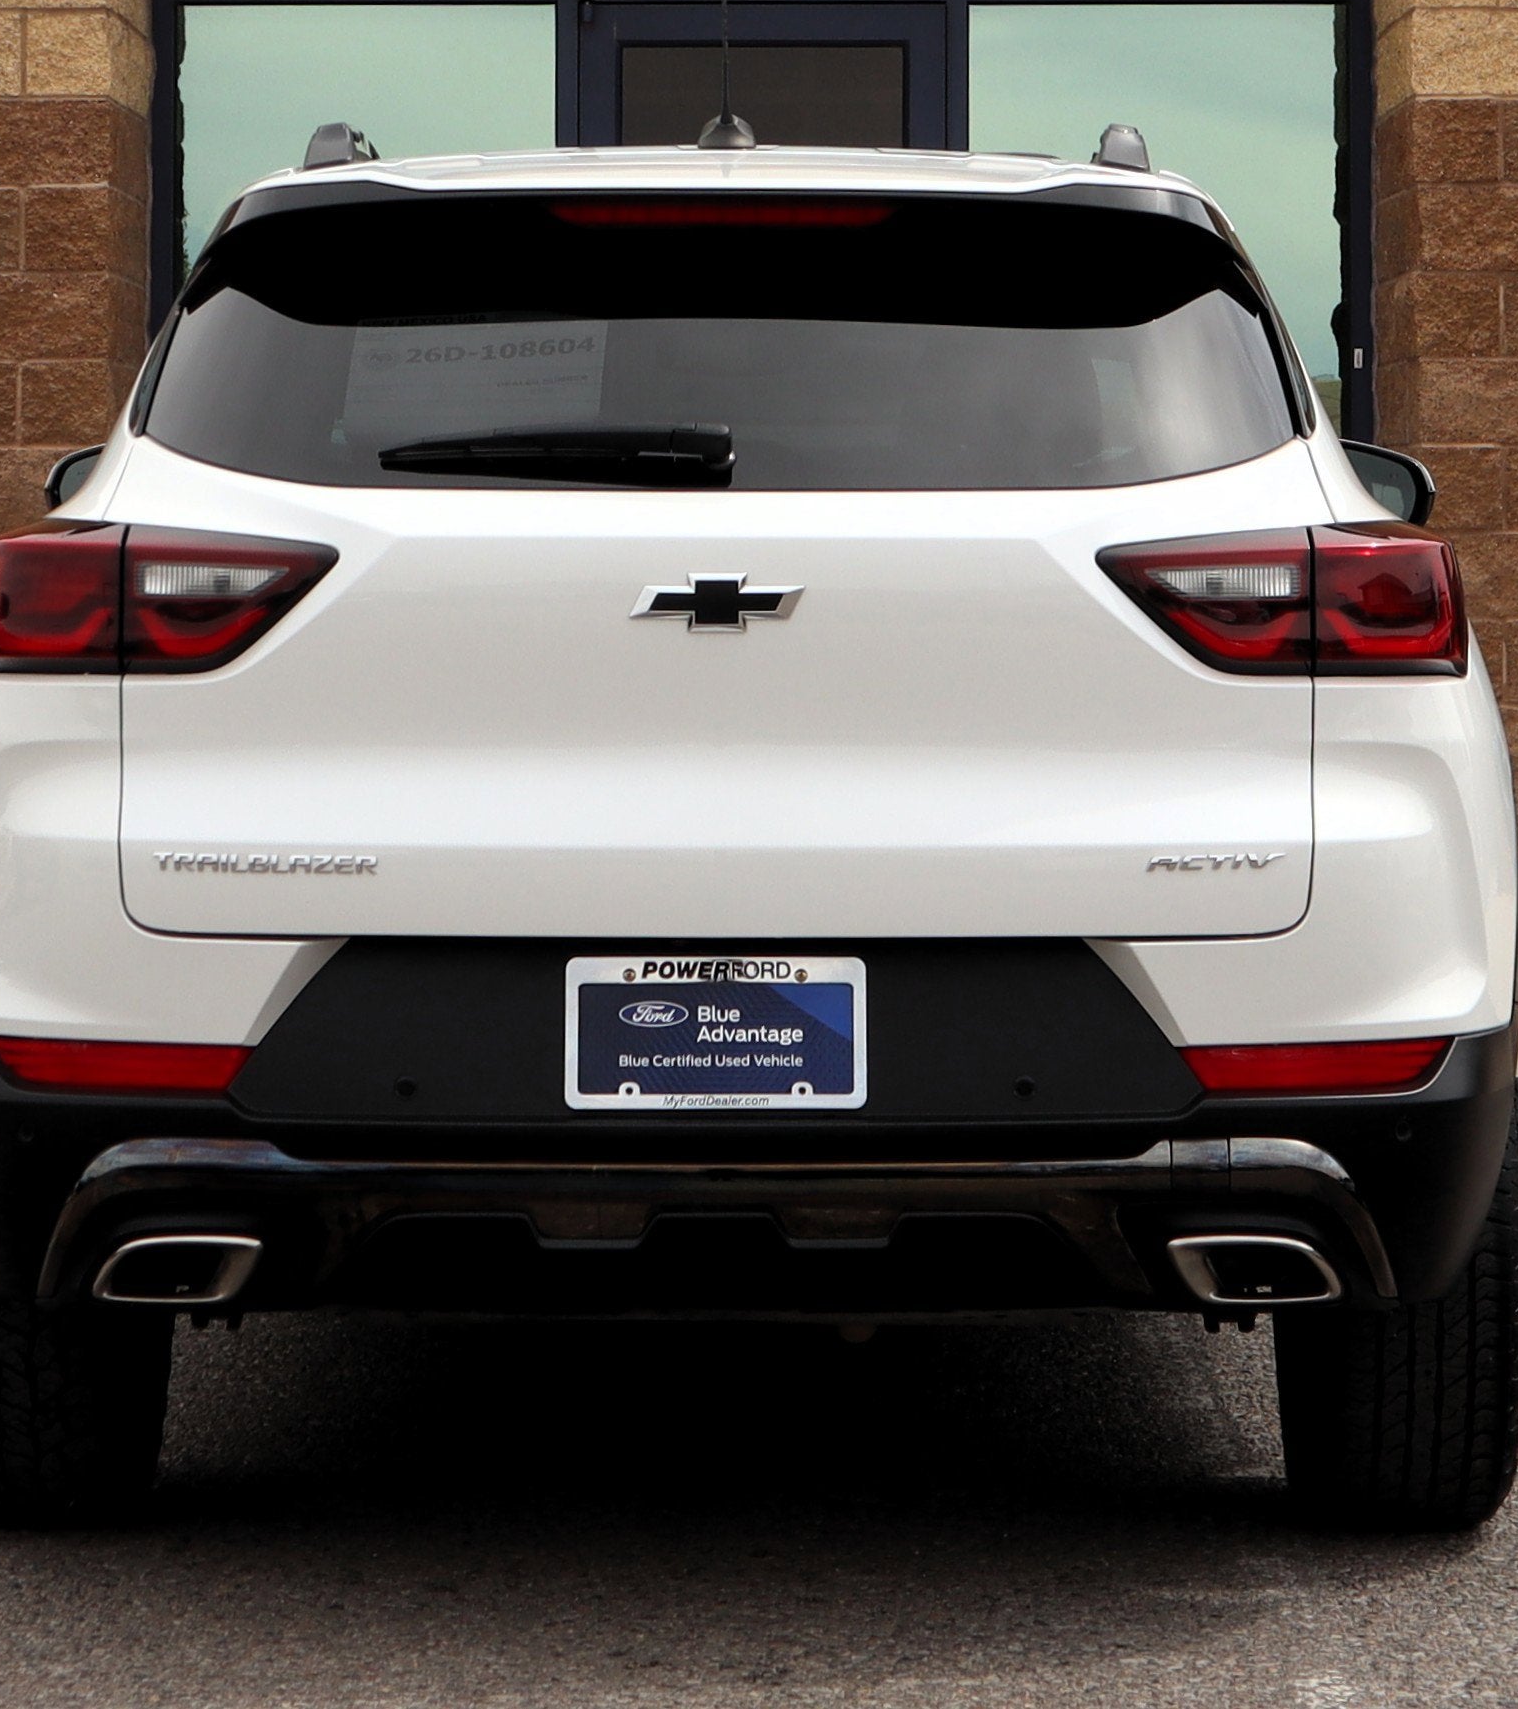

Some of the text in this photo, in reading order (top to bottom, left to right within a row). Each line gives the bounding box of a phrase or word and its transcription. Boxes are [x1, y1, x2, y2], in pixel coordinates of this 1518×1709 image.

[405, 336, 596, 364] 26D-108604
[153, 851, 379, 875] TRAILBLAZER
[1146, 852, 1287, 873] ACTIV
[632, 1004, 675, 1023] Ford
[697, 1005, 741, 1023] Blue
[696, 1025, 804, 1046] Advantage
[619, 1054, 804, 1067] Blue Certified Used Vehicle
[662, 1094, 770, 1109] MyFordDealer.com
